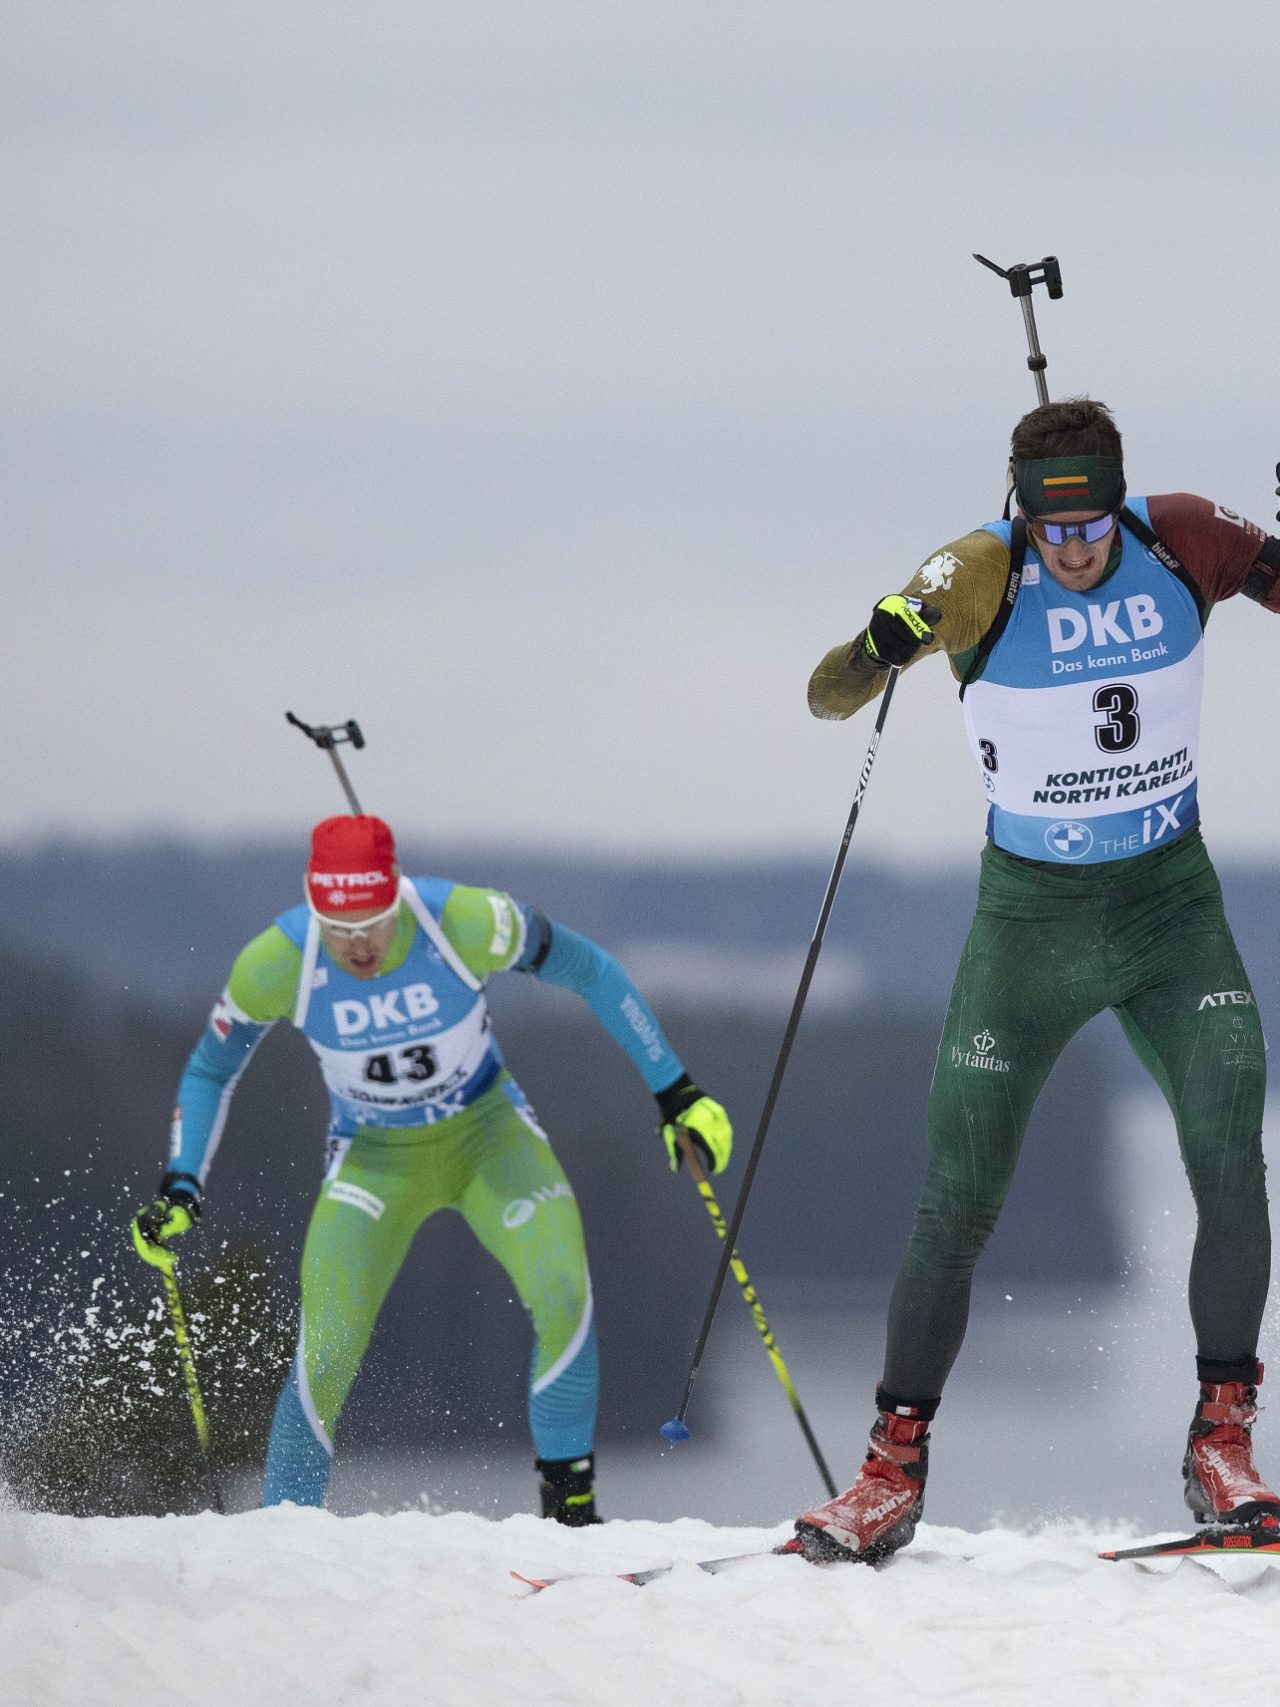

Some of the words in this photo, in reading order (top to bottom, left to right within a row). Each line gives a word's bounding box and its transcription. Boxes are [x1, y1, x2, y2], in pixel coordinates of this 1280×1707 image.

[1046, 593, 1164, 654] DKB
[1052, 659, 1083, 674] Das
[1087, 655, 1127, 669] kann
[1131, 641, 1169, 663] Bank
[1092, 683, 1141, 754] 3
[978, 738, 999, 774] 3
[1046, 747, 1188, 788] KONTIOLAHTI
[1032, 785, 1110, 804] NORTH
[1116, 760, 1193, 797] KARELIA
[1100, 833, 1139, 855] THE
[1142, 795, 1183, 845] iX
[332, 983, 439, 1036] DKB
[364, 1043, 440, 1086] 43
[951, 1046, 1010, 1073] Vytautas
[1202, 1444, 1235, 1487] alpina
[862, 1489, 912, 1525] alpina
